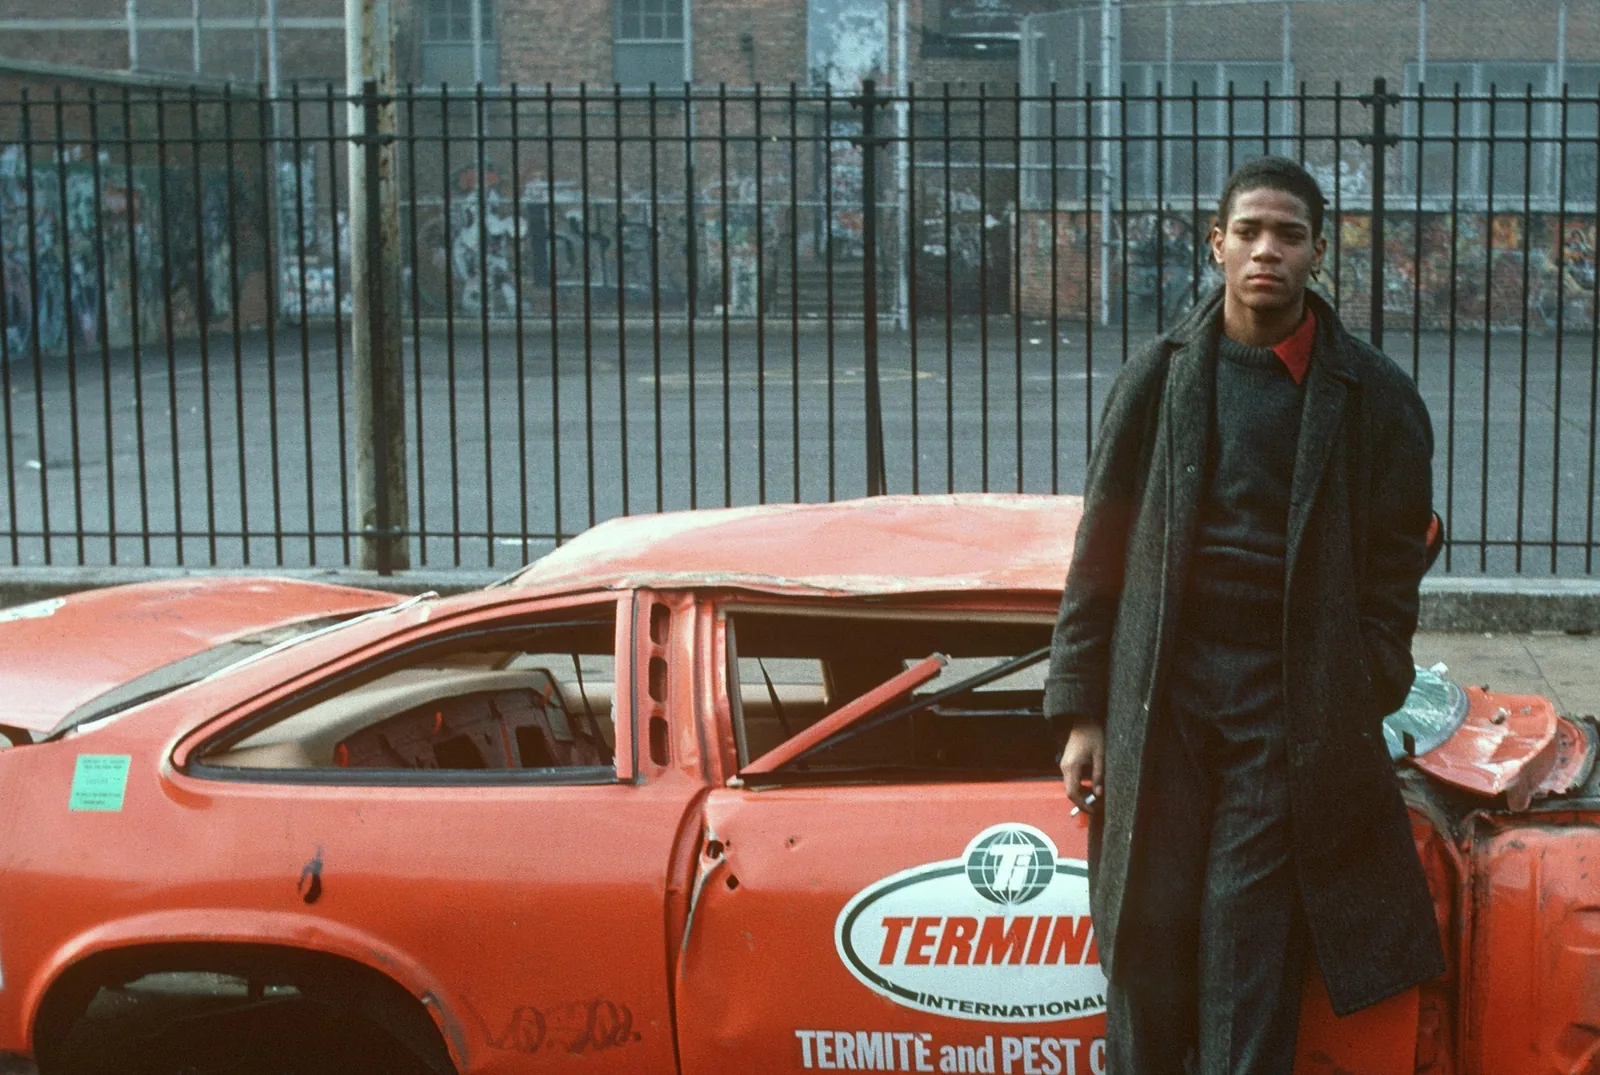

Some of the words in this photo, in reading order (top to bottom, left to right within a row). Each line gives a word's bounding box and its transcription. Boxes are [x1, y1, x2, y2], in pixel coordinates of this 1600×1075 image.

[917, 992, 1107, 1018] INTERNATIONAL
[795, 1029, 934, 1073] TERMITE
[939, 1035, 995, 1074] and
[1001, 1035, 1081, 1075] PEST
